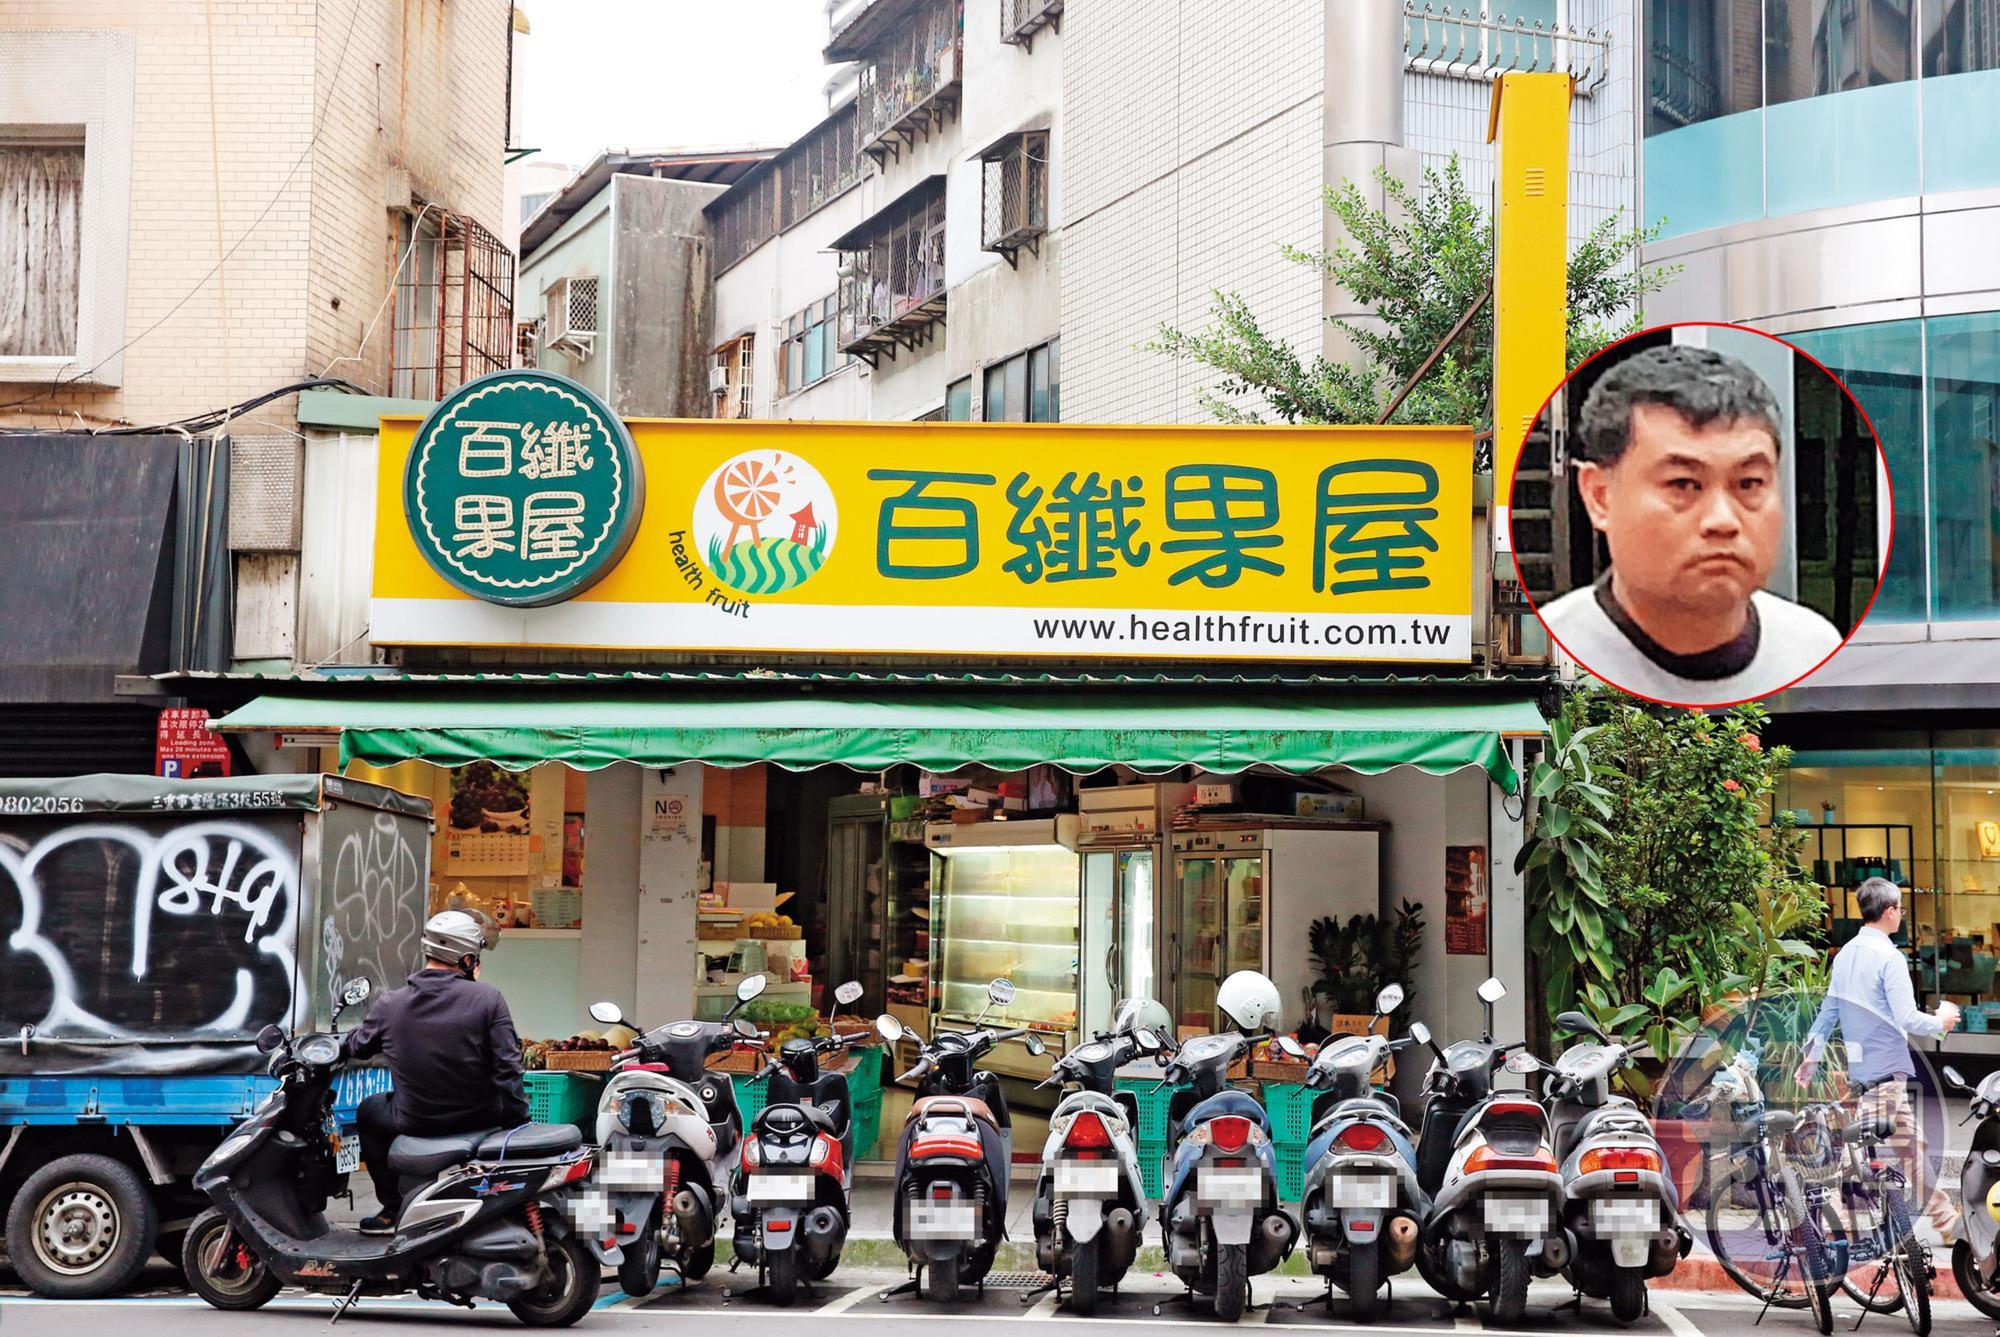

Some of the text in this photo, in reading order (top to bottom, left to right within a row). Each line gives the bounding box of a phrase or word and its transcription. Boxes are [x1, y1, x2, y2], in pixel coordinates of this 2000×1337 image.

[454, 419, 594, 481] 百纖
[452, 490, 586, 562] 果屋
[866, 458, 1440, 596] 百纖果屋
[669, 529, 752, 620] health fruit
[1033, 613, 1451, 647] www.healthfruit.com.tw
[164, 760, 178, 778] P
[0, 796, 84, 814] 802056
